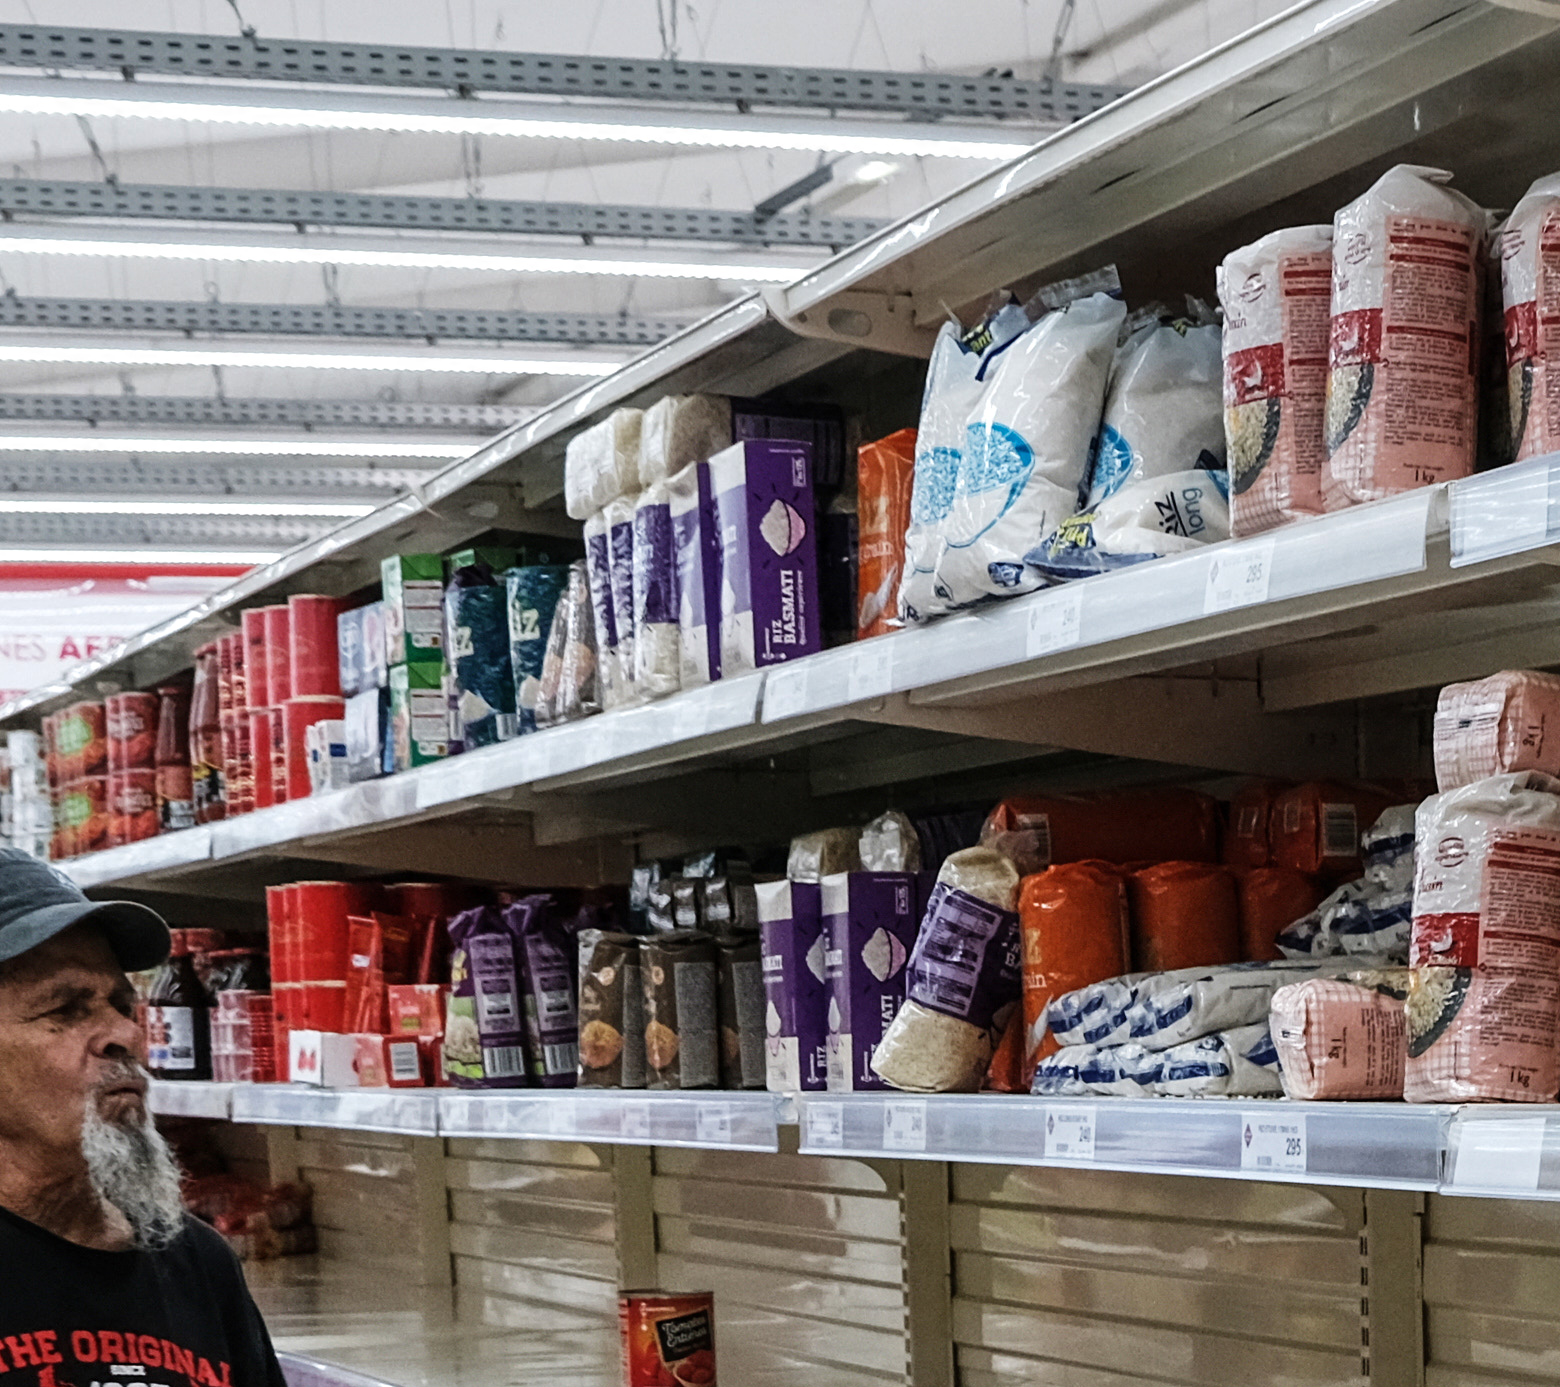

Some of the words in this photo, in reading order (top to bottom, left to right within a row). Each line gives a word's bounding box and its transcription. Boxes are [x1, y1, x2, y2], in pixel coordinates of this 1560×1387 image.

[1182, 488, 1205, 535] long
[781, 570, 796, 645] BASMATI
[1517, 1069, 1530, 1088] kg
[1285, 1137, 1302, 1156] 295
